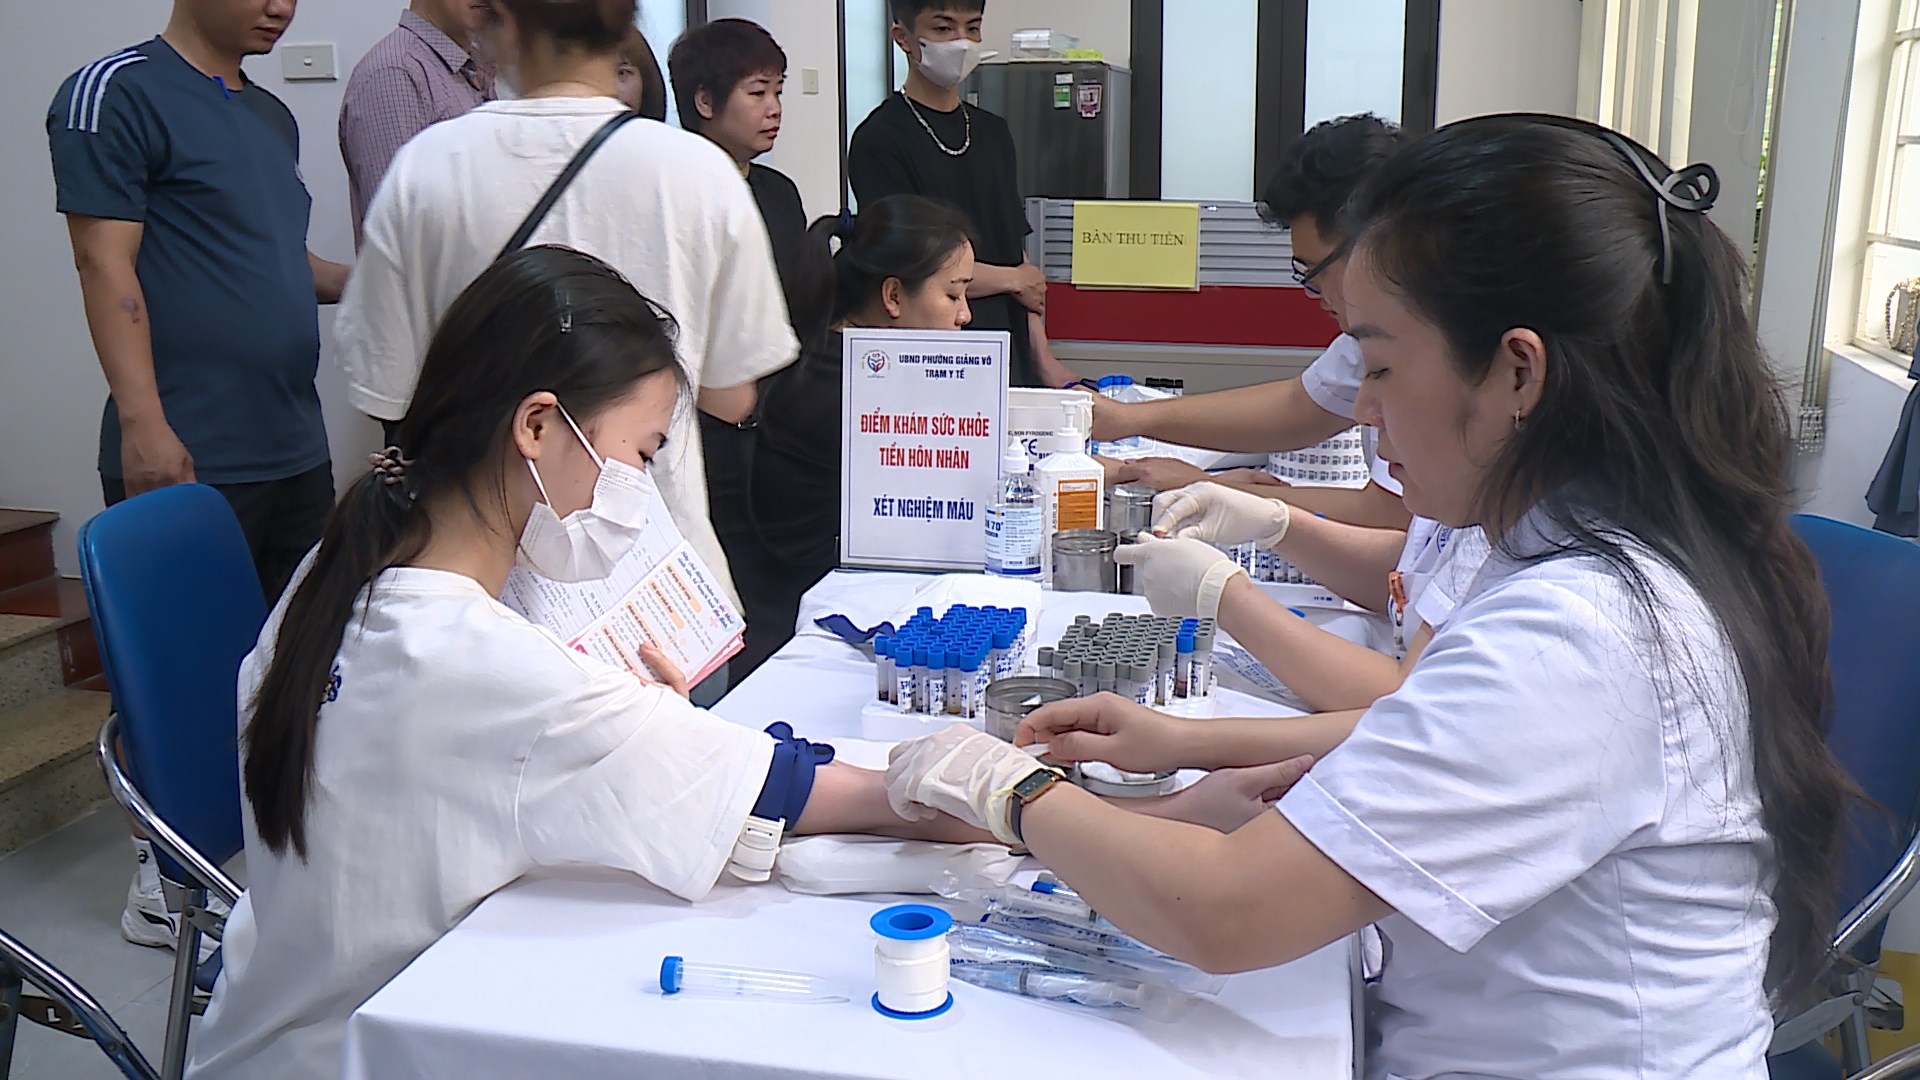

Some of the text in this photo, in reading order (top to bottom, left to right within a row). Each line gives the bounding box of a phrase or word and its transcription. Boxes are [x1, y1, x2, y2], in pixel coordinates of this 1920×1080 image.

[1082, 228, 1113, 244] BÀN
[1116, 232, 1147, 245] THU
[899, 354, 920, 364] UBND
[922, 353, 953, 365] PHƯỜNG
[955, 353, 980, 366] GIẢNG
[925, 368, 965, 381] TRẠM Y TẾ
[860, 407, 990, 437] ĐIỂM KHÁM SỨC KHỎE
[908, 445, 932, 468] HÔN
[936, 446, 969, 469] NHÂN
[873, 494, 974, 522] XÉT NGHIỆM MÁU
